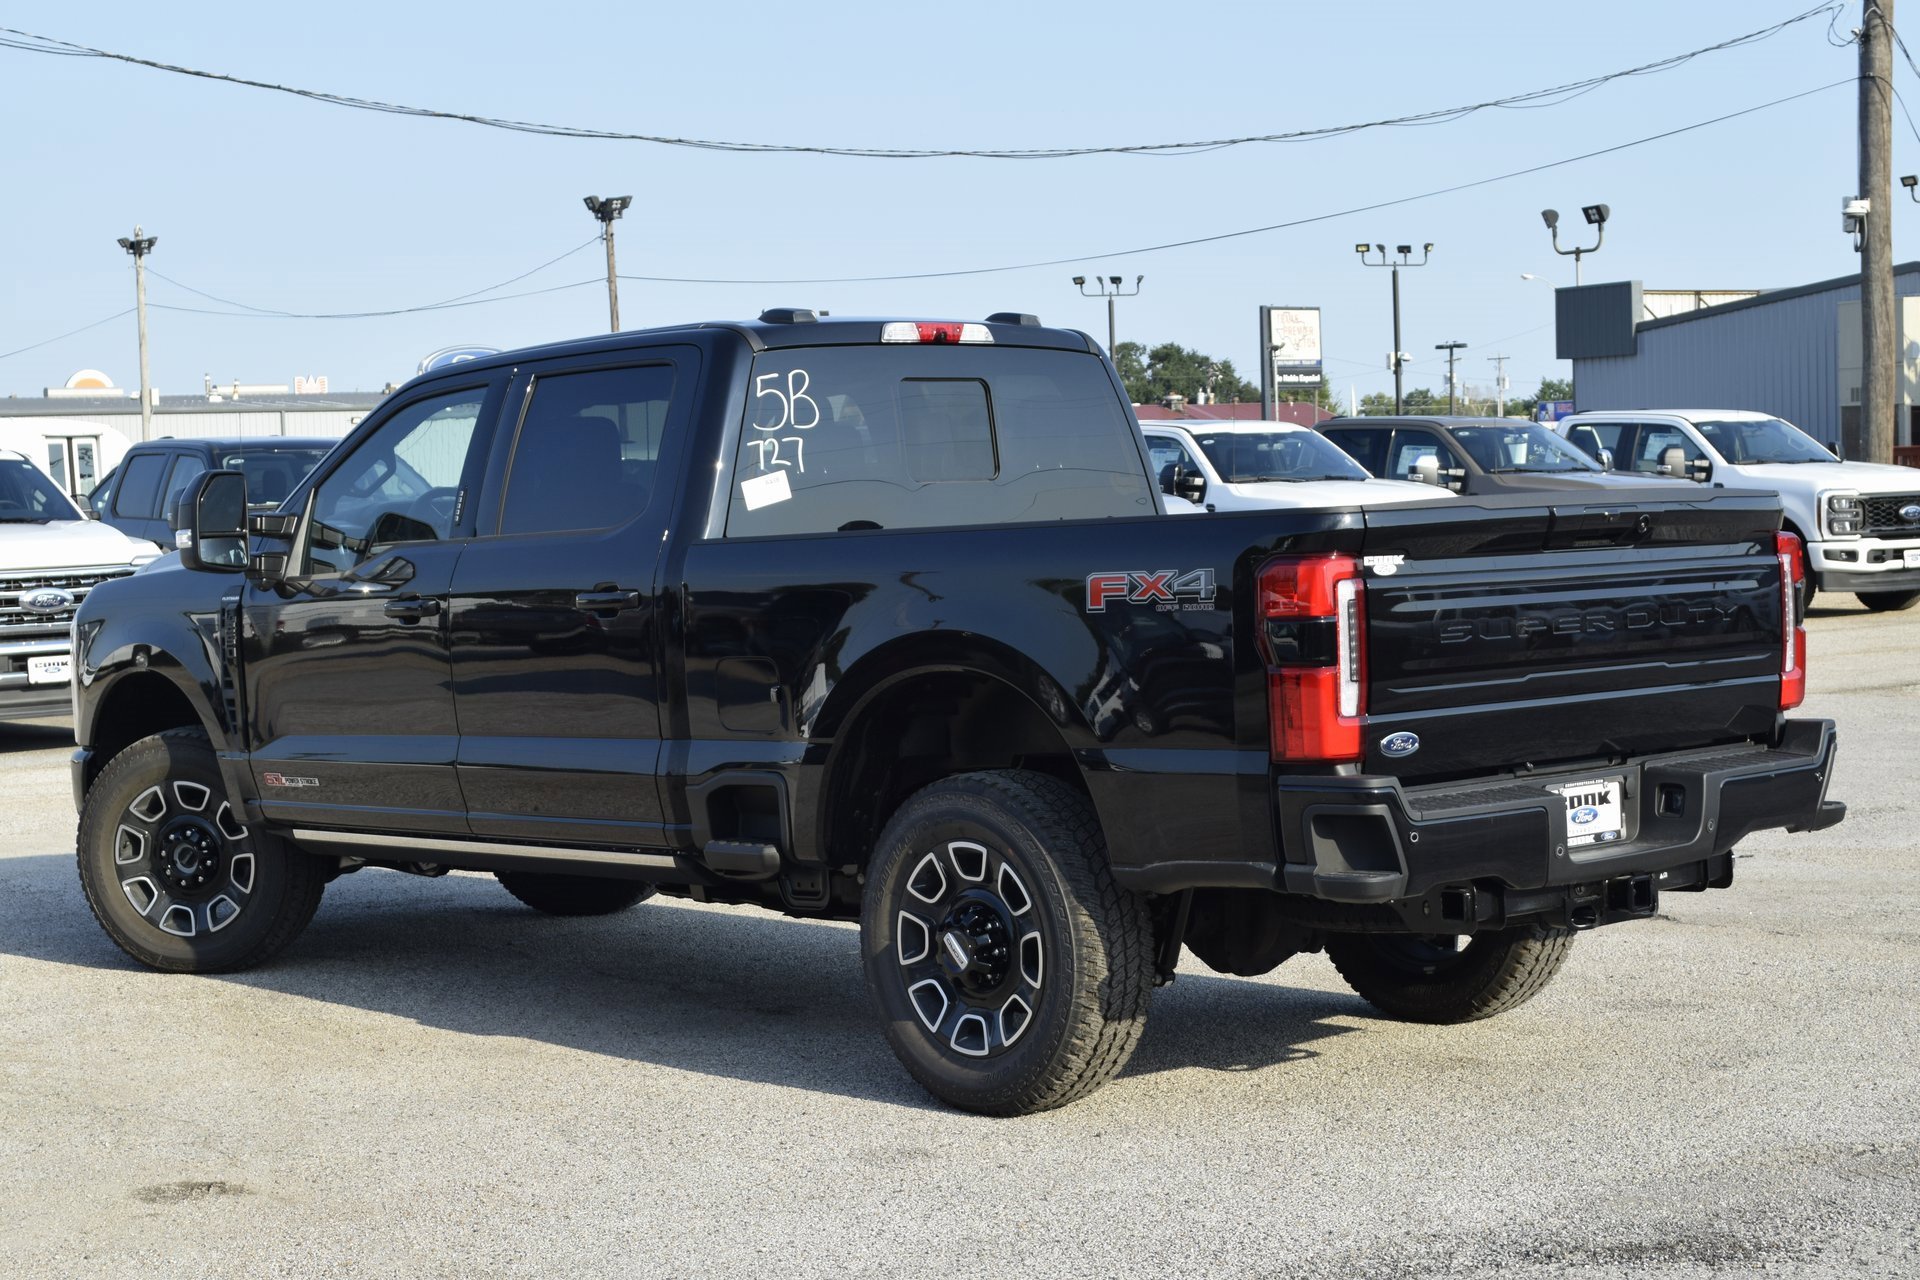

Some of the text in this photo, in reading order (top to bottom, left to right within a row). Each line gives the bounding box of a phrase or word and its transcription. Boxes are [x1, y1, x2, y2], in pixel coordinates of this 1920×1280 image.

[753, 369, 820, 431] 5B
[747, 436, 805, 473] 727
[1363, 554, 1405, 566] COOK
[1086, 568, 1217, 613] FX4
[1156, 603, 1215, 612] OFF ROAD
[1440, 604, 1739, 643] SUPER DUTY
[1391, 736, 1413, 750] Ford
[1566, 790, 1611, 810] OOK
